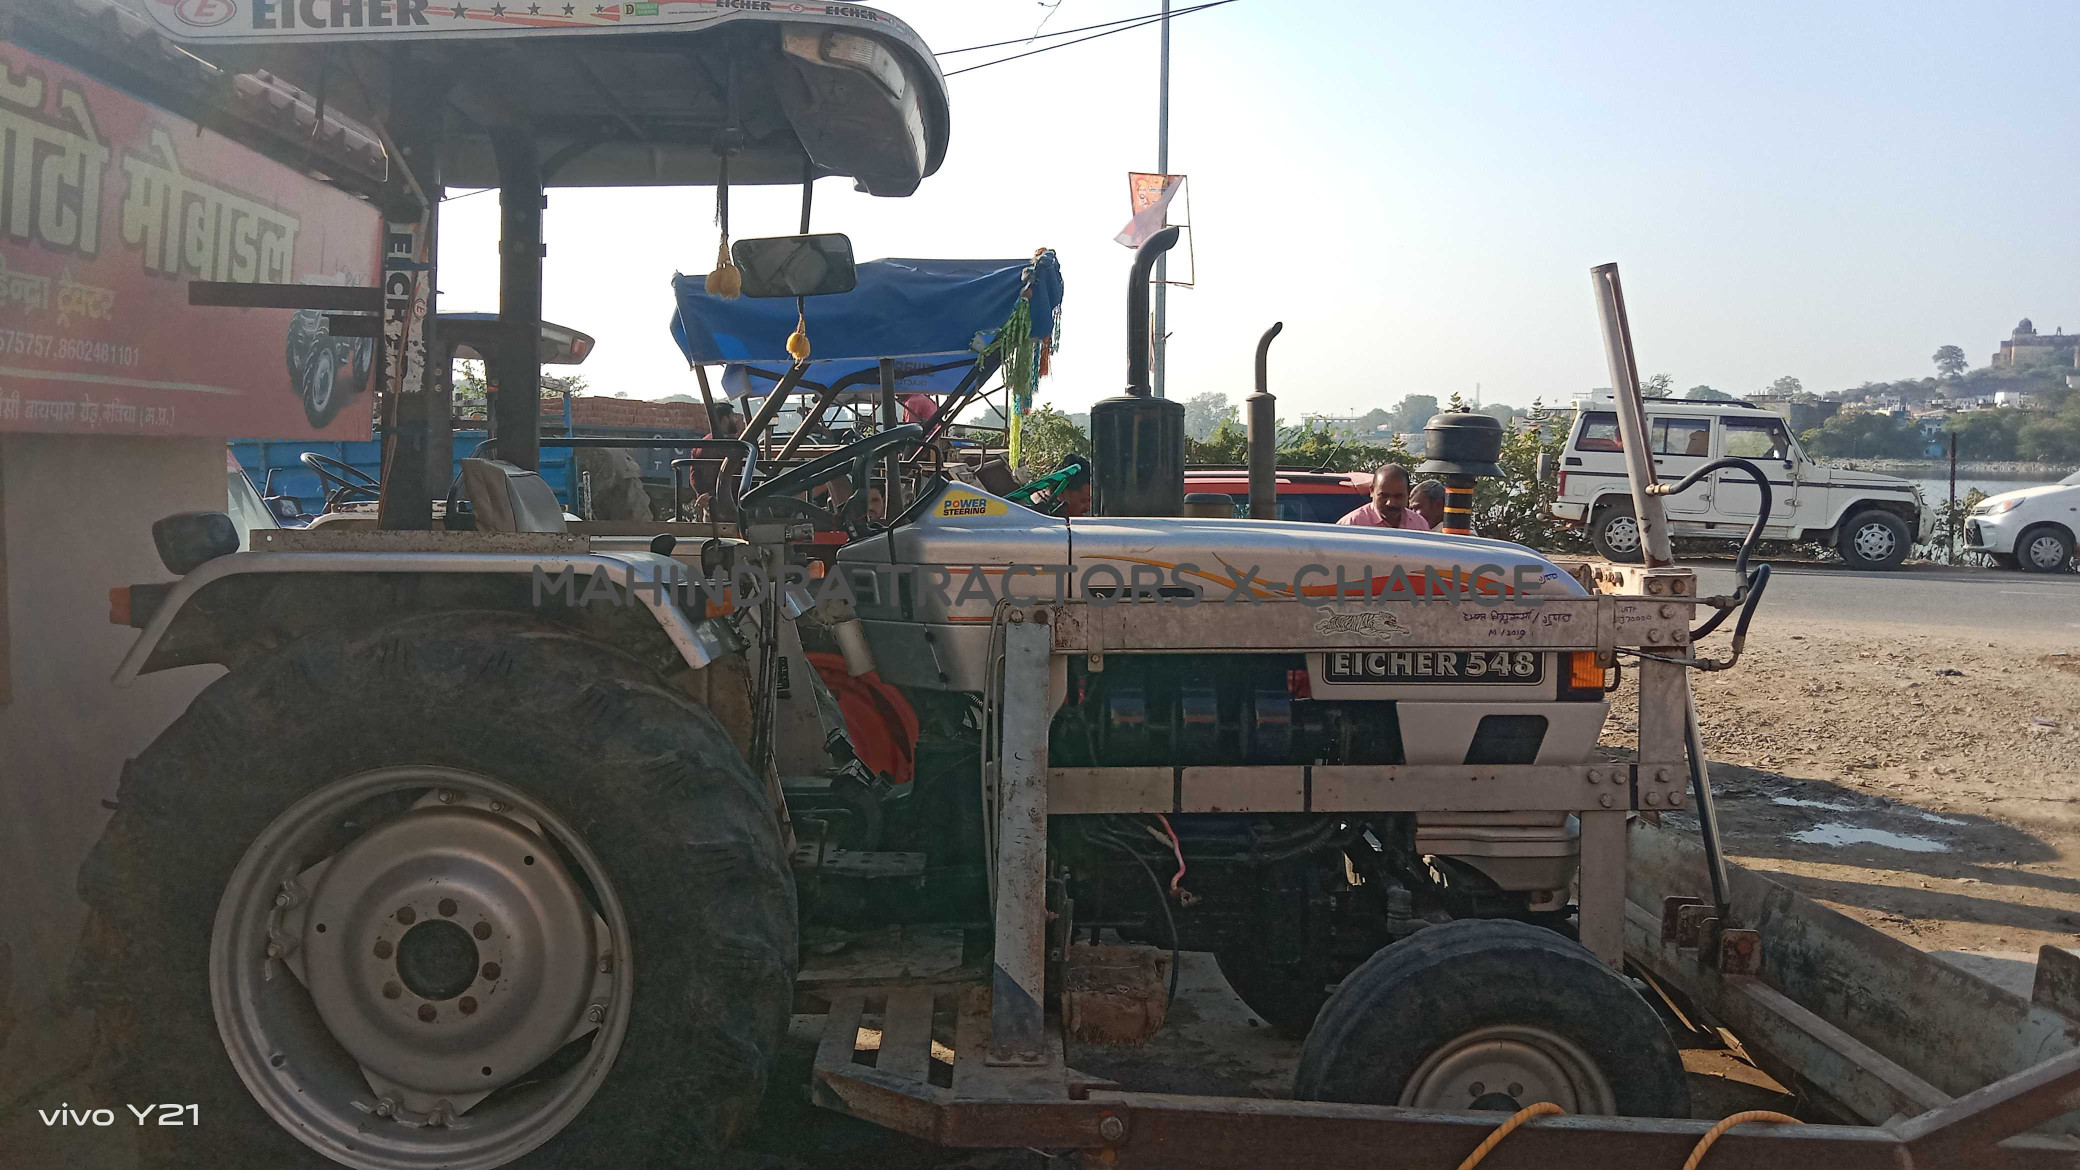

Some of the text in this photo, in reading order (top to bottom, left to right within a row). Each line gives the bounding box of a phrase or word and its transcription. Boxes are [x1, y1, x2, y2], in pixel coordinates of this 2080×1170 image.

[716, 0, 771, 10] EICHER
[253, 0, 429, 29] EICHER
[825, 6, 878, 21] EICHER
[944, 498, 987, 509] POWER
[943, 507, 986, 516] STEERING
[1331, 651, 1537, 677] EICHER 548
